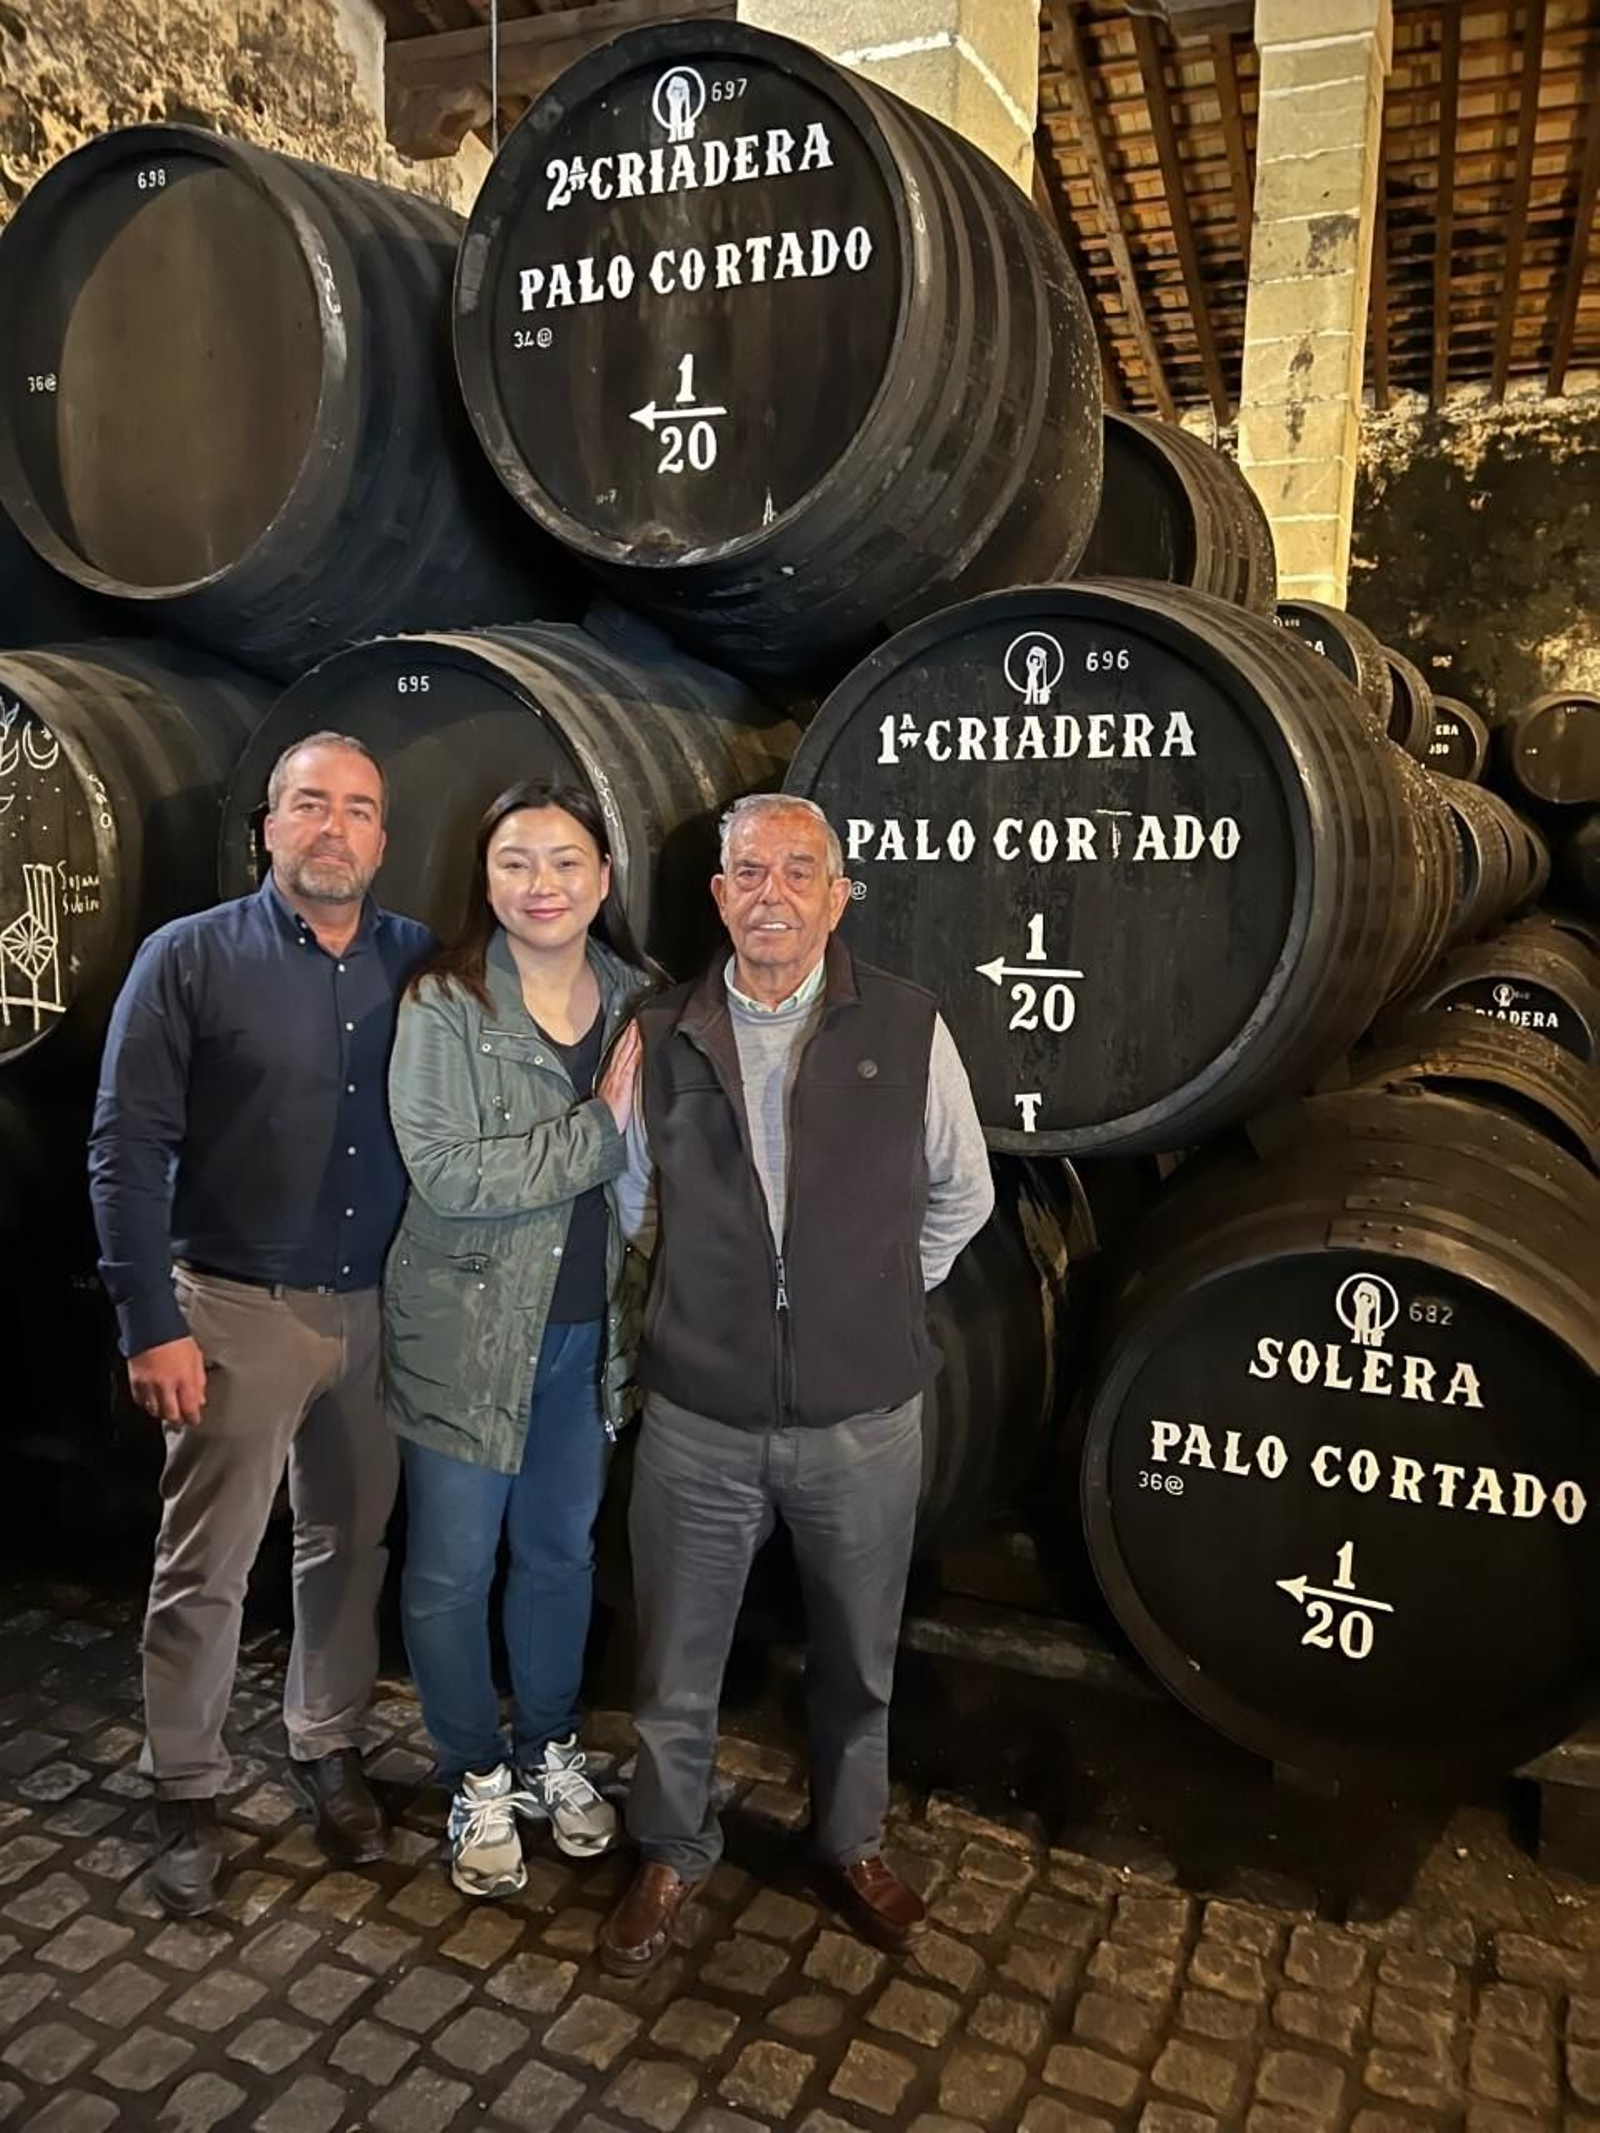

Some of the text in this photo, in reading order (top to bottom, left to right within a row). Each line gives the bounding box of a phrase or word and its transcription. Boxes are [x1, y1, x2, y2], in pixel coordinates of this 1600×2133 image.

[711, 78, 748, 102] 697
[137, 168, 166, 190] 698
[588, 122, 834, 200] CRIADERA
[519, 225, 873, 313] PALO CORTADO
[675, 353, 697, 403] 1
[657, 420, 718, 475] 20
[397, 675, 431, 694] 695
[1085, 649, 1131, 673] 696
[924, 711, 1198, 763] CRIADERA
[846, 818, 977, 862] PALO
[1025, 913, 1048, 961] 1
[1008, 981, 1076, 1033] 20
[1409, 1302, 1454, 1325] 682
[1248, 1336, 1486, 1409] SOLERA
[1138, 1470, 1185, 1496] 36@
[1150, 1419, 1588, 1526] PALO CORTADO
[1332, 1540, 1357, 1591] 1
[1301, 1600, 1374, 1660] 20
